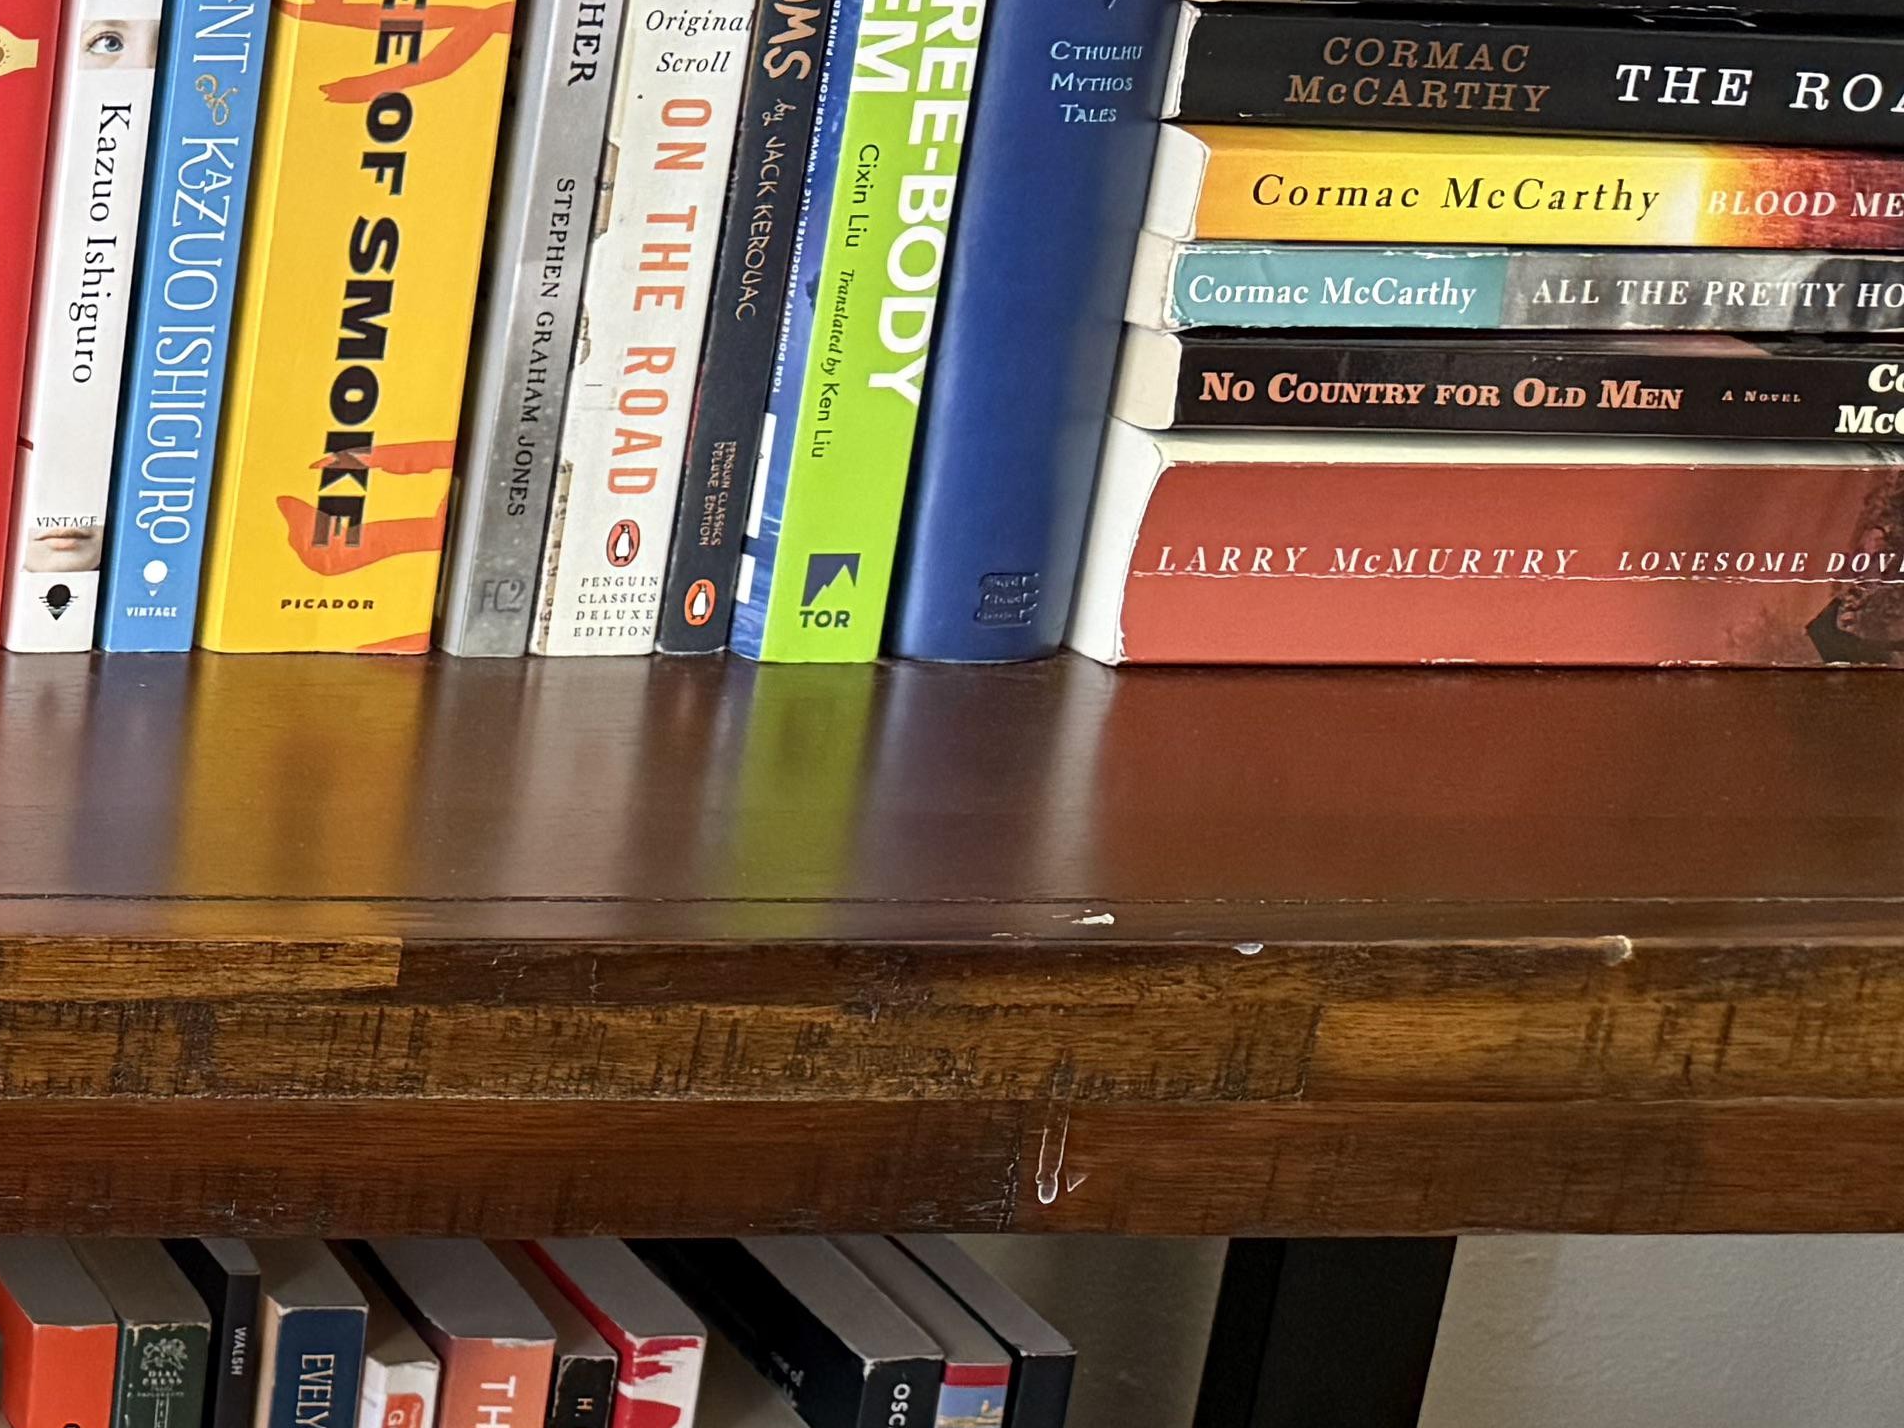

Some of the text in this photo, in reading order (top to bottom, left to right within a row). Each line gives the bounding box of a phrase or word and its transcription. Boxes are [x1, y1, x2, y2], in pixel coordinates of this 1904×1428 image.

[644, 8, 753, 36] Original
[1051, 40, 1142, 61] CTHULHU
[654, 50, 731, 73] Scroll
[1051, 72, 1133, 93] MYTHOS
[1060, 102, 1117, 123] TALES
[844, 142, 881, 248] Cixin Liu
[1251, 173, 1660, 220] Cormac McCarthy
[1158, 545, 1579, 576] LARRY McMURTRY
[580, 576, 660, 590] PENGUIN
[577, 592, 657, 604] CLASSICS
[576, 608, 654, 622] DELUXE
[798, 608, 851, 628] TOR
[573, 624, 652, 638] EDITION
